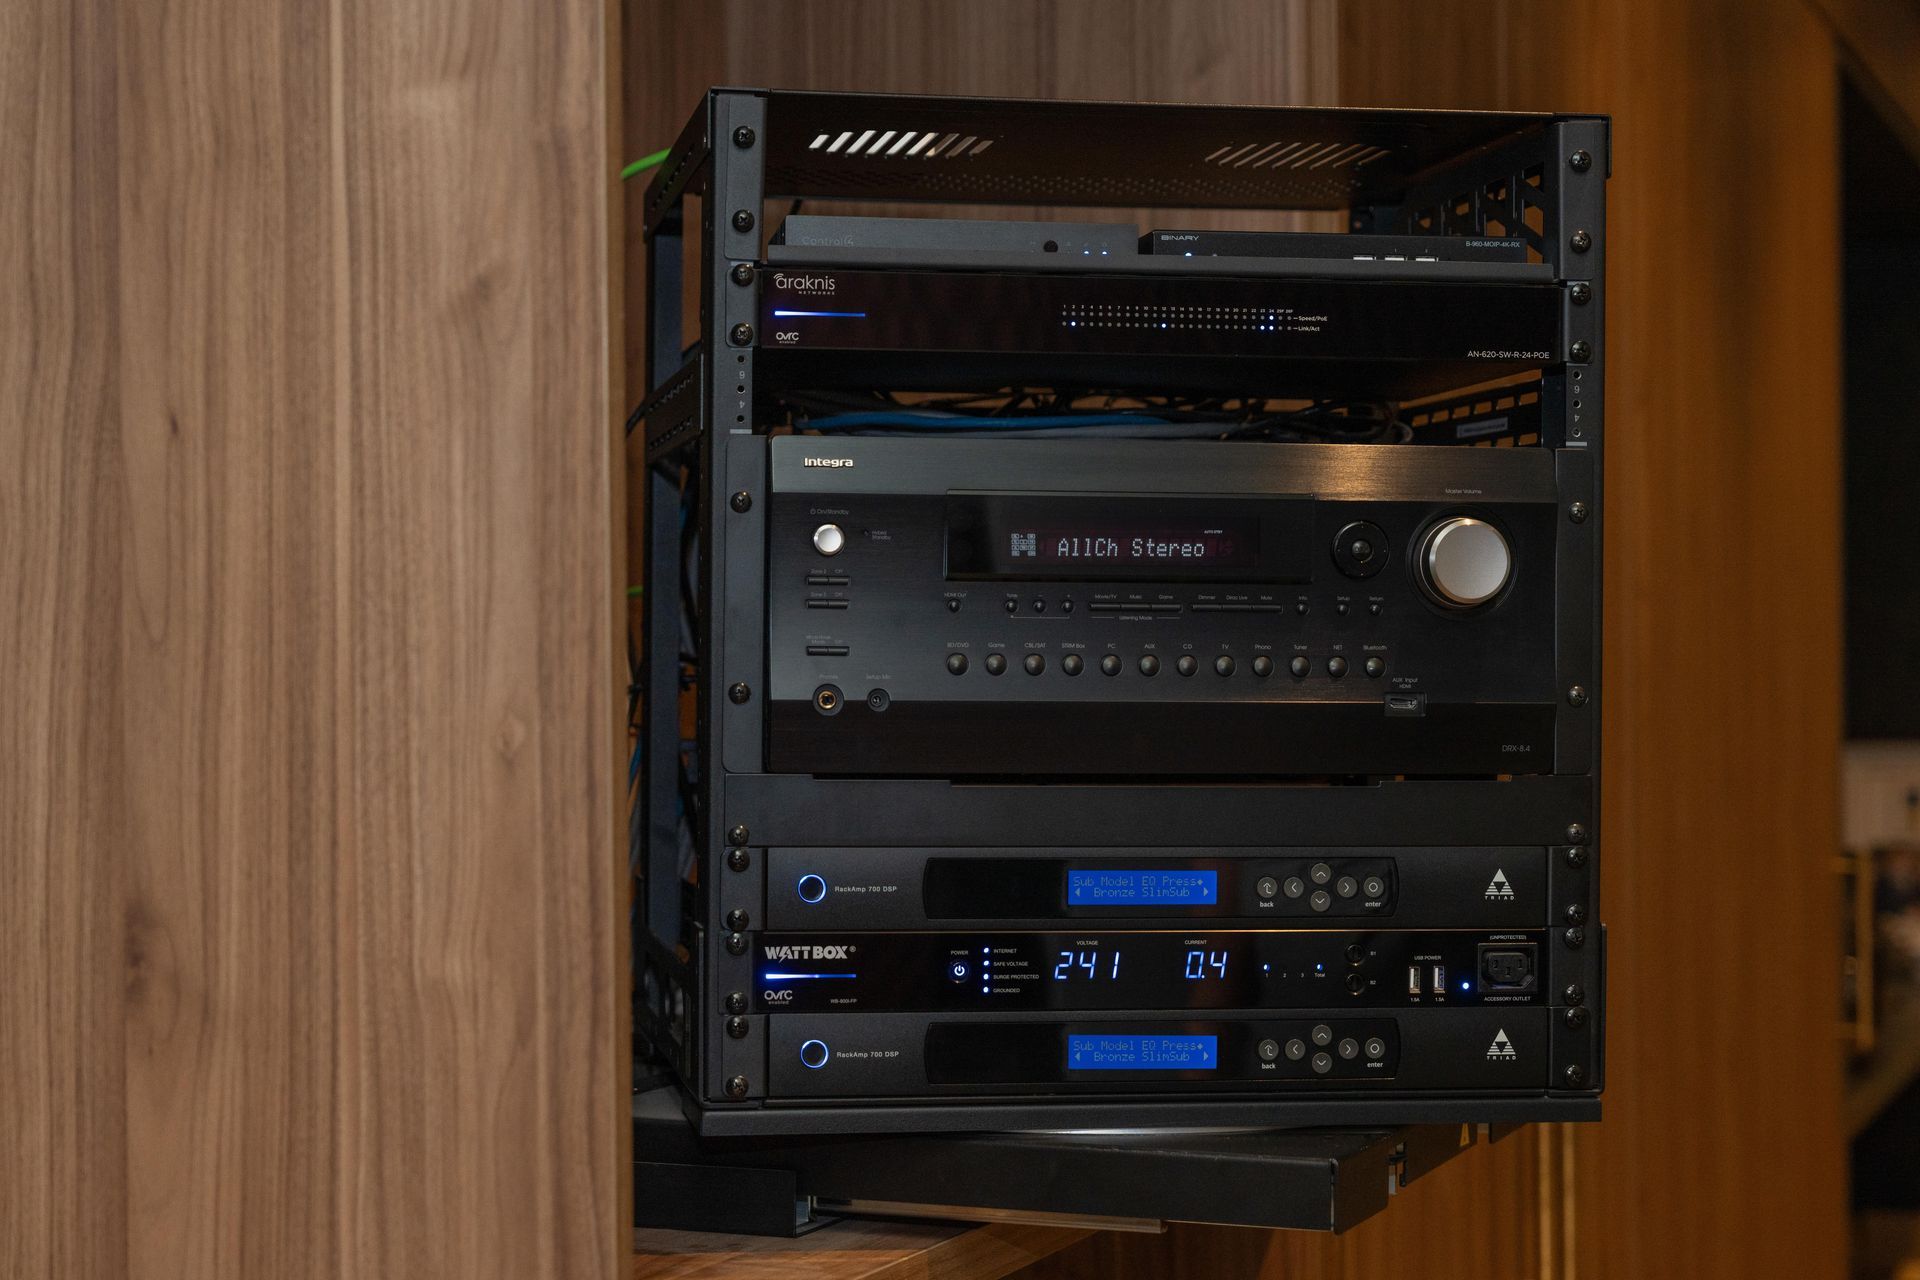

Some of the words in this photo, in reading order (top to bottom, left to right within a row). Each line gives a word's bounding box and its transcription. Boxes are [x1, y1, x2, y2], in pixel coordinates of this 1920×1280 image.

[774, 273, 836, 290] araknis
[1467, 351, 1551, 359] AN-620-SW-R-24-POE
[804, 457, 854, 468] Integra
[1058, 537, 1118, 557] AllCh
[1132, 537, 1205, 557] Stereo
[1073, 876, 1094, 886] Sub
[1100, 876, 1134, 886] Model
[1162, 876, 1196, 886] Press
[834, 886, 866, 894] RackAmp
[1093, 887, 1136, 897] Bronze
[1141, 886, 1190, 897] SlimSub
[1054, 951, 1120, 979] 241
[1184, 951, 1228, 979] 0.4
[1073, 1040, 1094, 1051] Sub
[1100, 1040, 1134, 1051] Model
[1162, 1040, 1196, 1051] Press
[836, 1051, 868, 1059] RackAmp
[1093, 1051, 1136, 1062] Bronze
[1141, 1051, 1190, 1062] SlimSub
